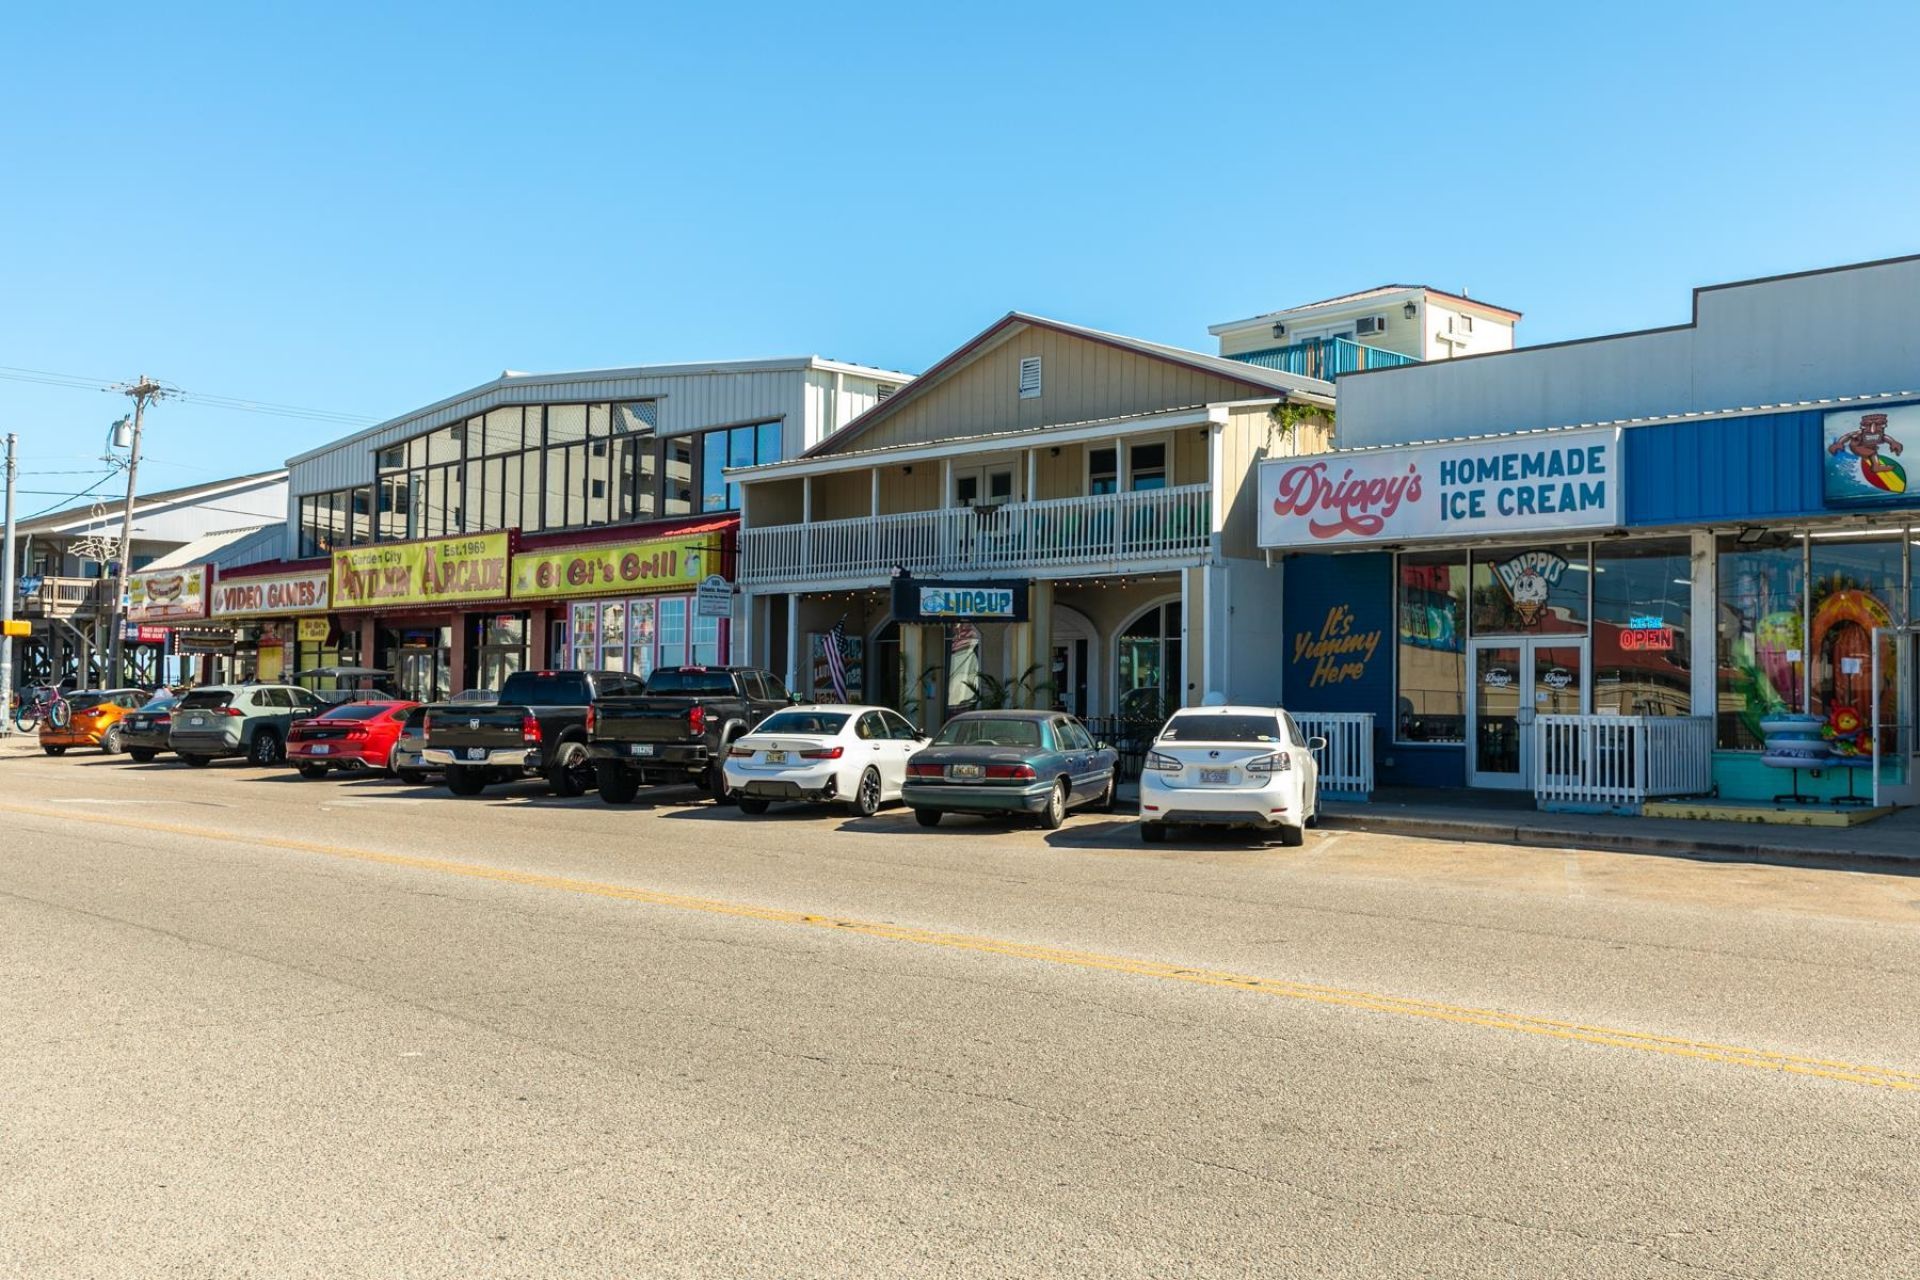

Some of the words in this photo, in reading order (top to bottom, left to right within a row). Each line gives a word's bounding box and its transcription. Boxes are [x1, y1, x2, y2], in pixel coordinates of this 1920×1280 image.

[1440, 446, 1606, 486] HOMEMADE
[1274, 462, 1422, 538] Drippy's
[1440, 489, 1486, 521] ICE
[1497, 480, 1606, 517] CREAM
[352, 553, 383, 566] Garden
[384, 550, 402, 564] City
[620, 550, 677, 581] Grill
[224, 585, 263, 611] VIDEO
[267, 580, 316, 609] GAMES
[1320, 604, 1355, 641] It's
[1619, 628, 1673, 650] OPEN
[1293, 629, 1381, 665] Yummy
[1310, 655, 1364, 687] Here
